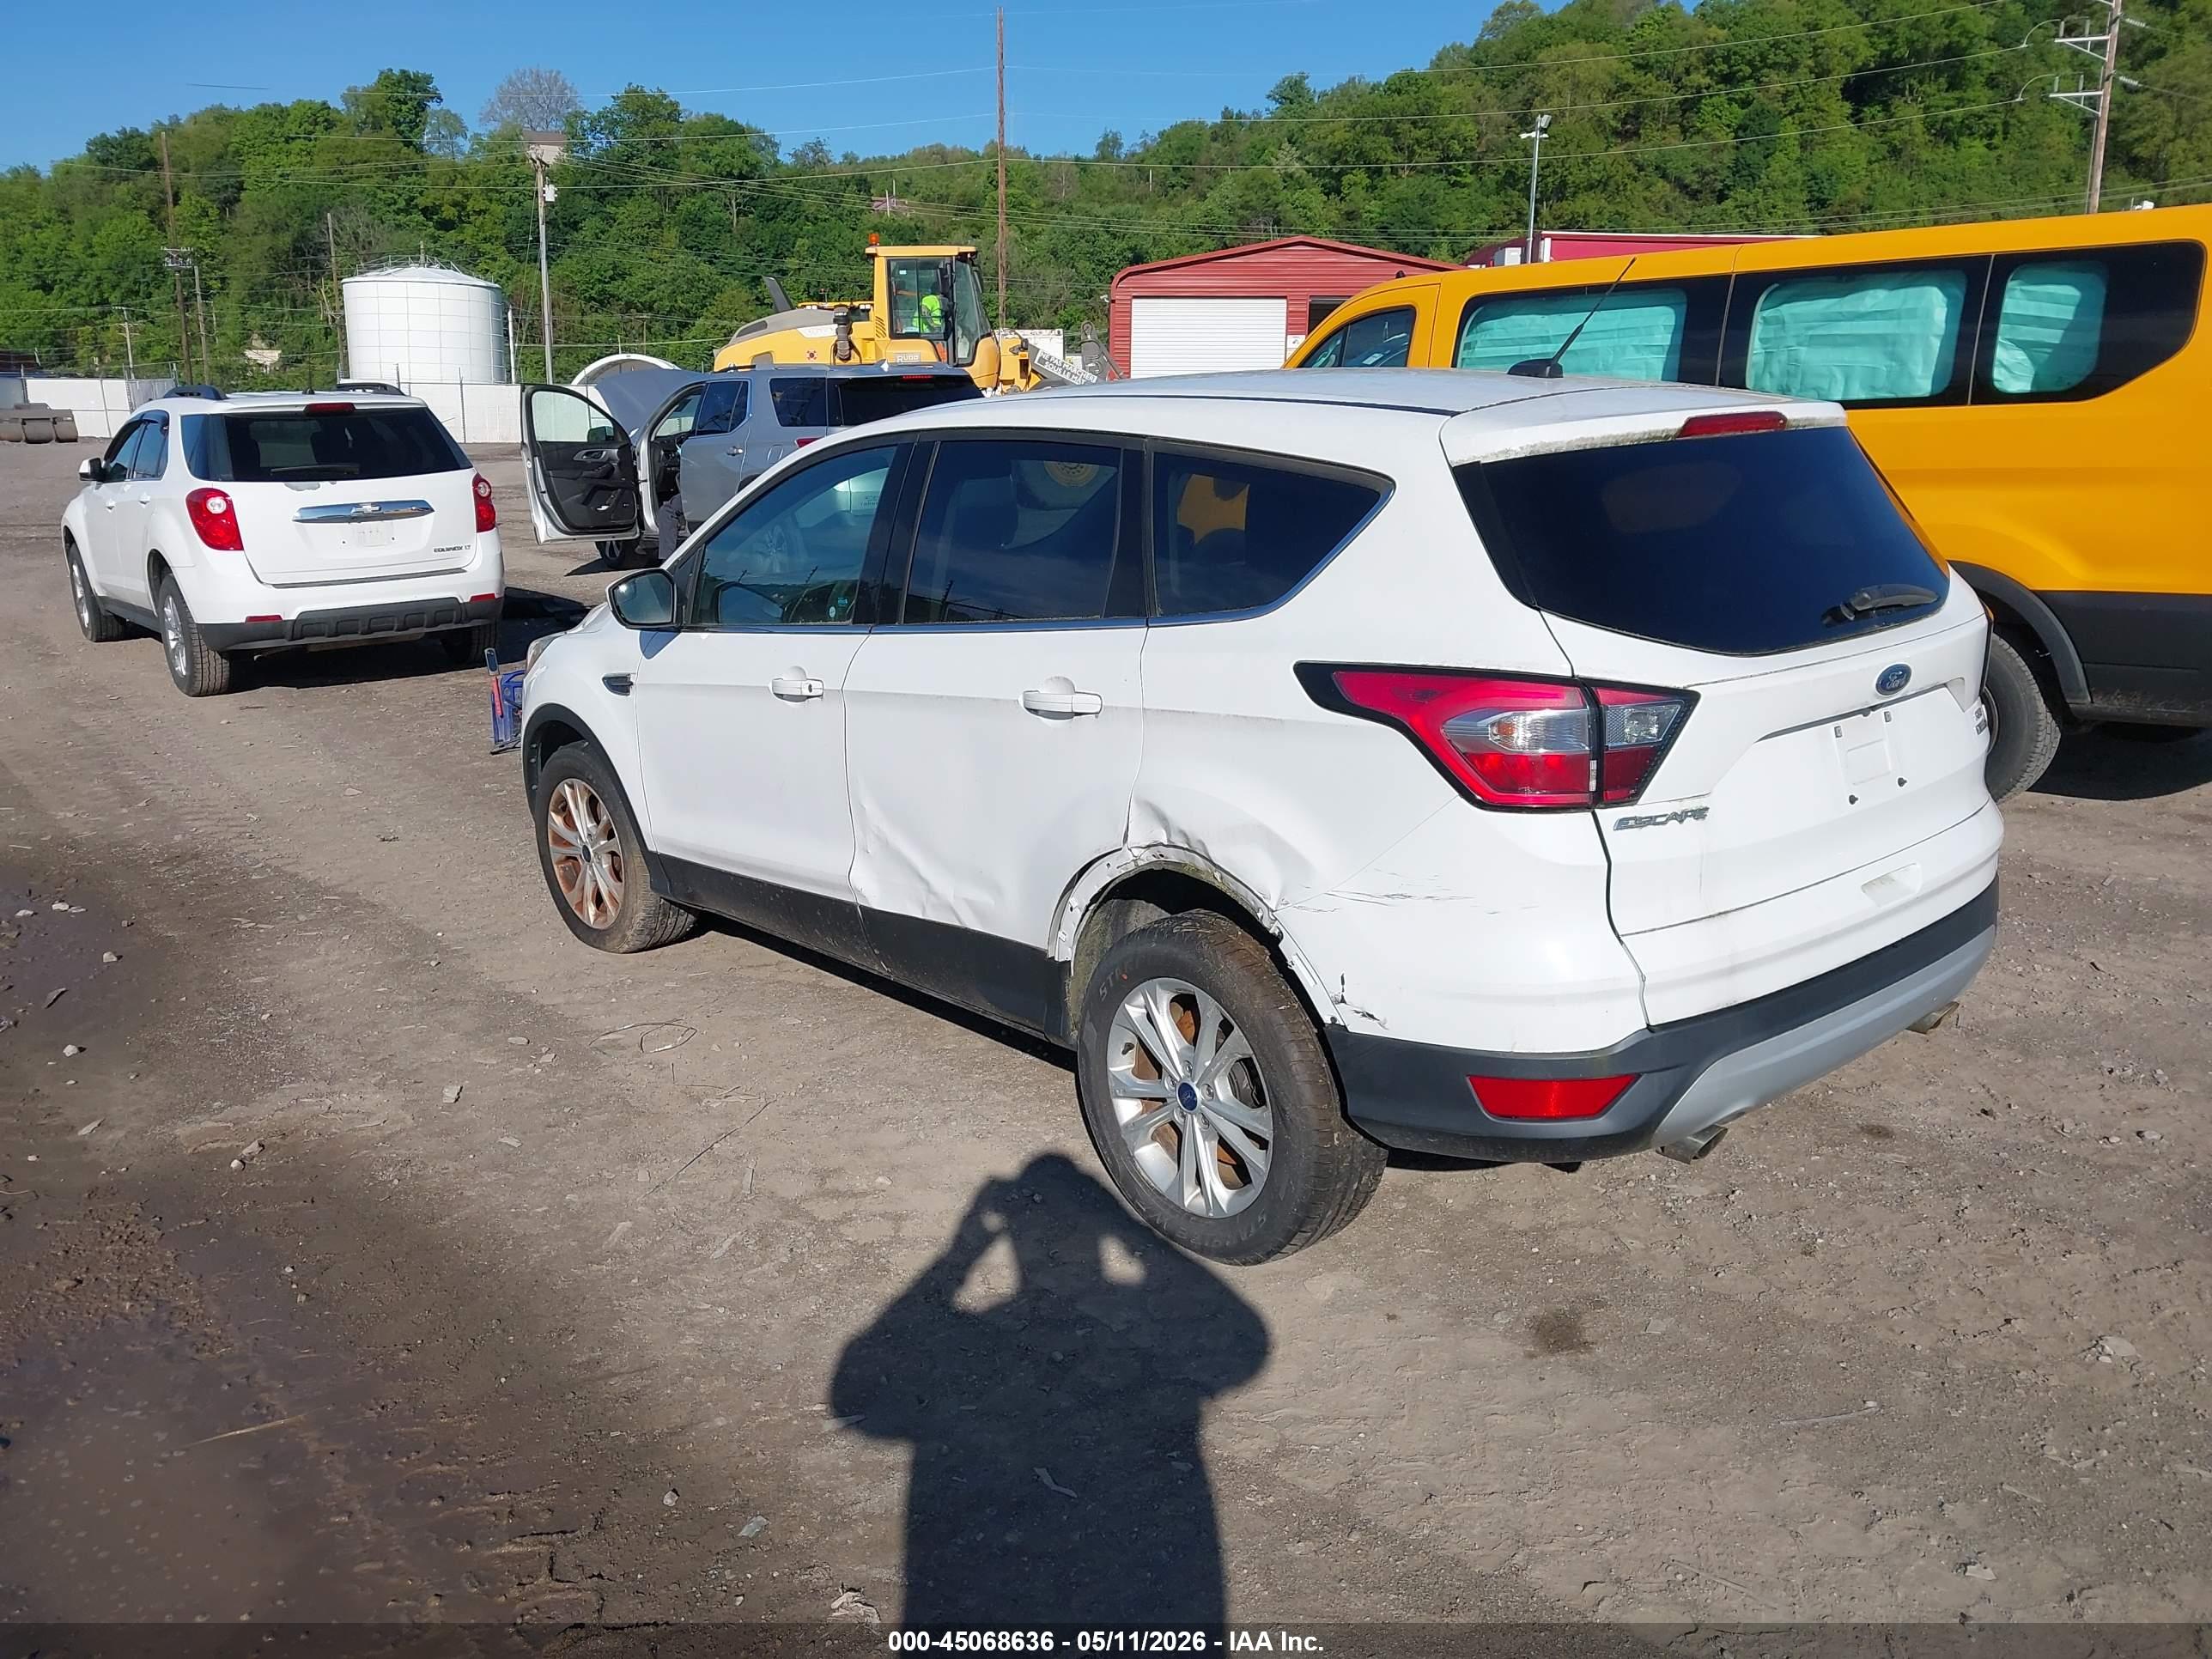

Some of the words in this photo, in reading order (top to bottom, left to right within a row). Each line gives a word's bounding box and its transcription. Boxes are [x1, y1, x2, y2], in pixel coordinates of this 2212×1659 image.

[1040, 351, 1049, 361] NE
[1049, 356, 1062, 367] PAS
[1044, 361, 1063, 374] SOUS
[1613, 806, 1711, 830] ESCAPE
